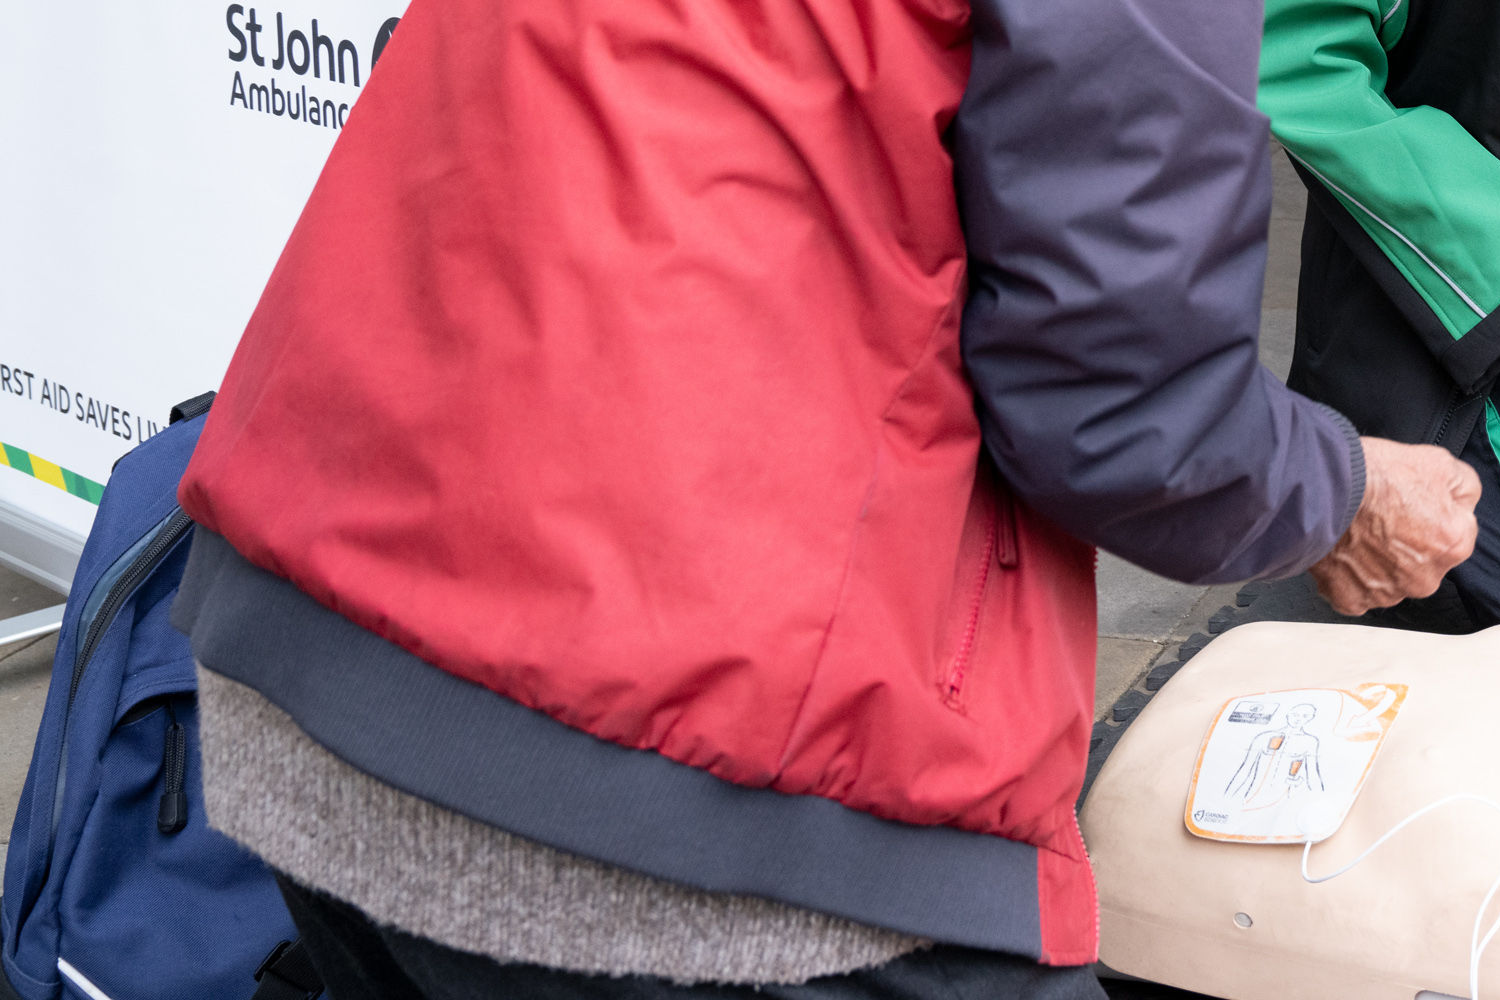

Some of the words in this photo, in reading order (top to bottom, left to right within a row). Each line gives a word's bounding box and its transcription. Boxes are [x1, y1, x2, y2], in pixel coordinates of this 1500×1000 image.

[226, 3, 265, 67] St
[272, 11, 360, 88] John
[230, 70, 348, 129] Ambulanc
[0, 363, 34, 400] RST
[41, 378, 70, 414] AID
[75, 392, 132, 441] SAVES
